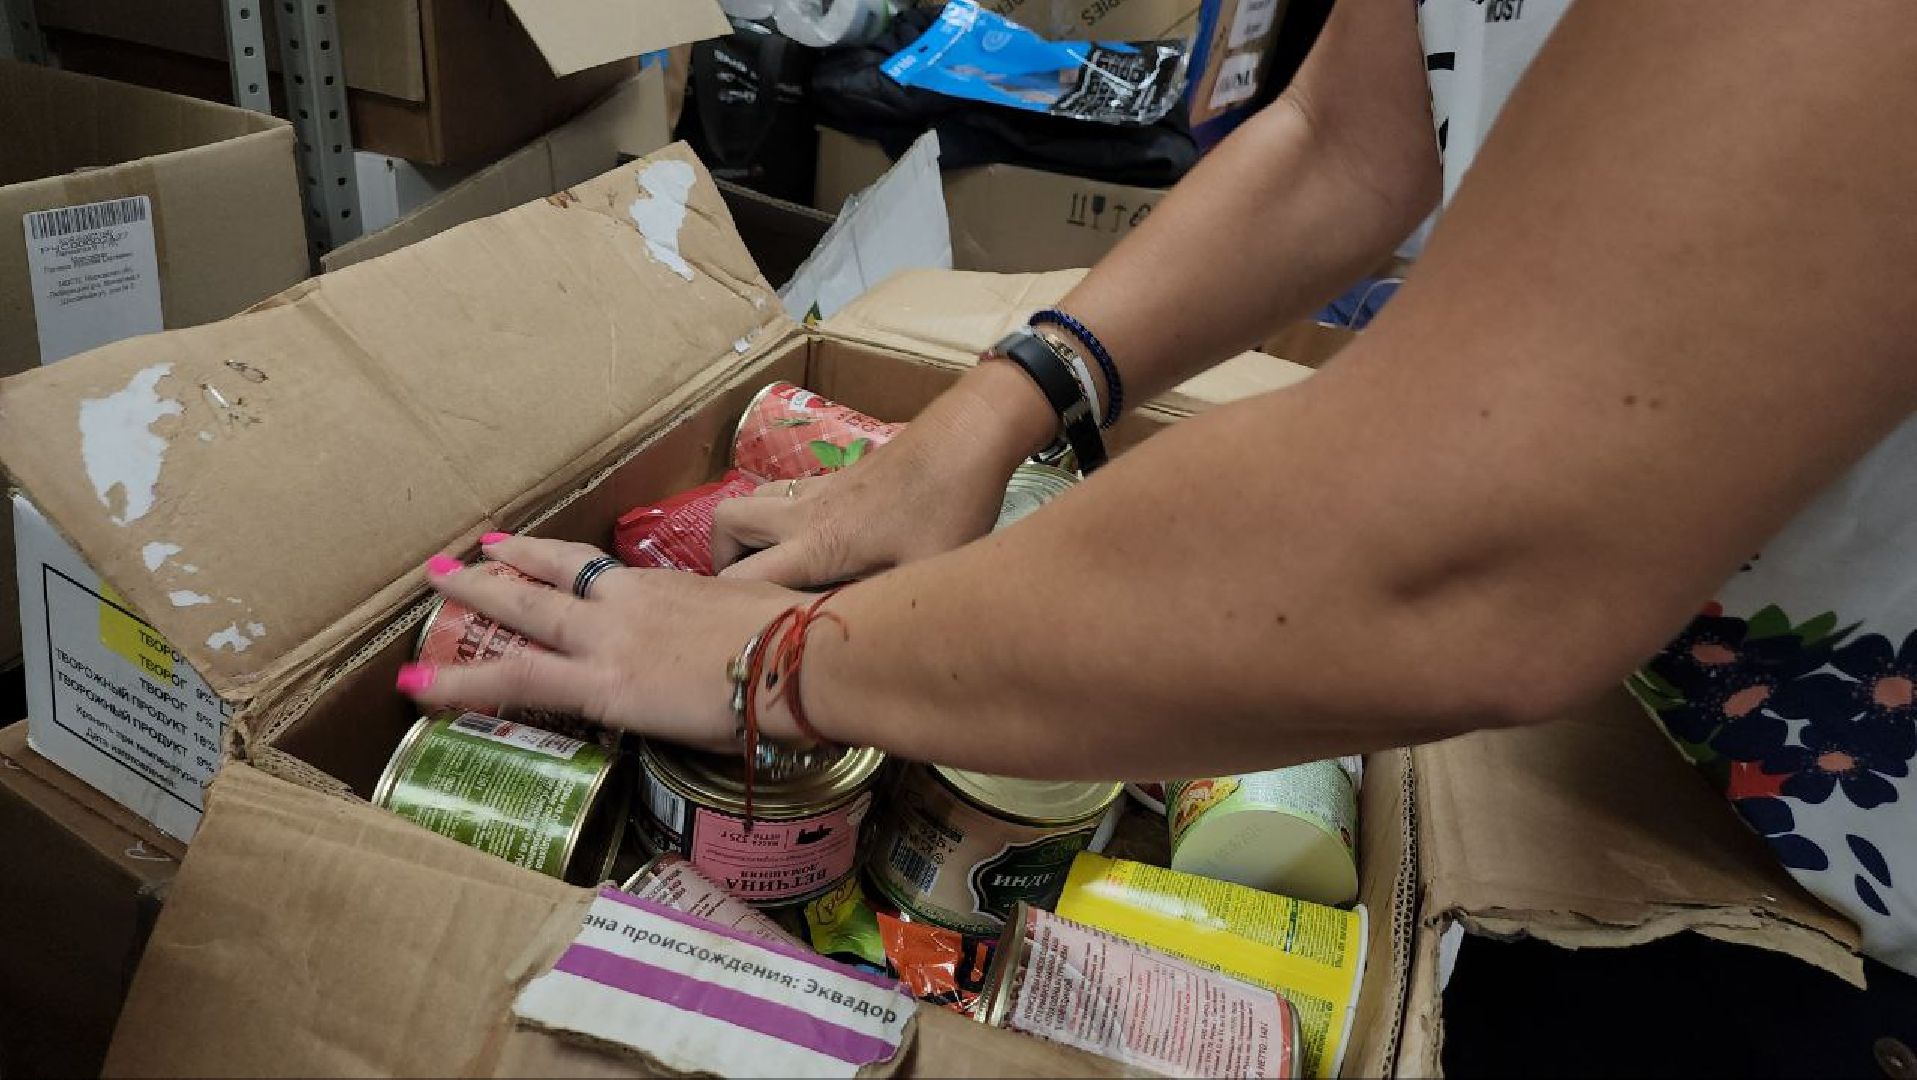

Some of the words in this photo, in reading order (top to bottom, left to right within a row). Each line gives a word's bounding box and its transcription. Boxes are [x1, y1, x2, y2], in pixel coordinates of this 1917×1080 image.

[55, 648, 130, 701] ТВОРОЖНЫЙ
[131, 696, 188, 735] ПРОДУКТ
[138, 653, 187, 689] ТВОРОГ
[139, 677, 188, 711] ТВОРОГ
[56, 670, 131, 724] ТВОРОЖНЫЙ
[132, 718, 188, 757] ПРОДУКТ
[725, 869, 827, 892] ВЕТЧИНА
[621, 923, 799, 989] происхождения:
[803, 978, 897, 1025] Эквадор
